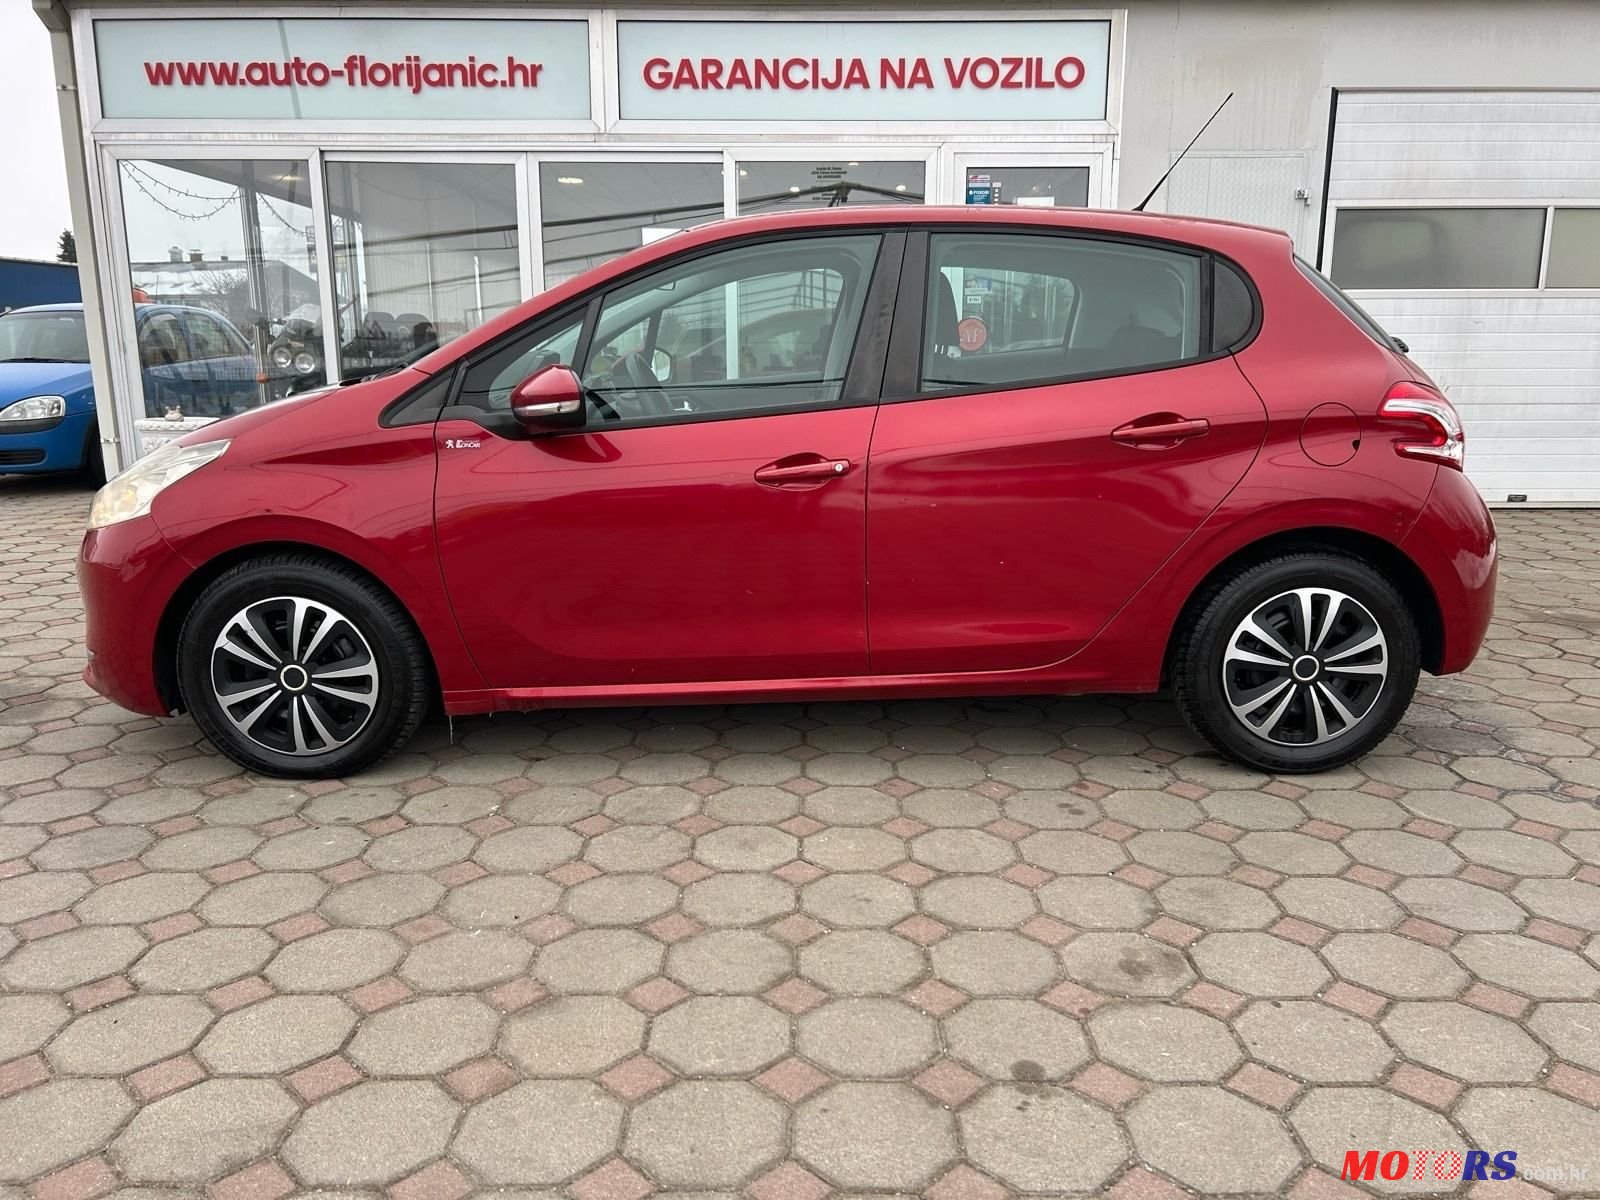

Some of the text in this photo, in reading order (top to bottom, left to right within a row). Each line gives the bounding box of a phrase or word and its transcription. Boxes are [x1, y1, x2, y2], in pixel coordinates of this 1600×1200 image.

[144, 54, 543, 95] www.auto-florijanic.hr
[643, 56, 1086, 91] GARANCIJA NA VOZILO
